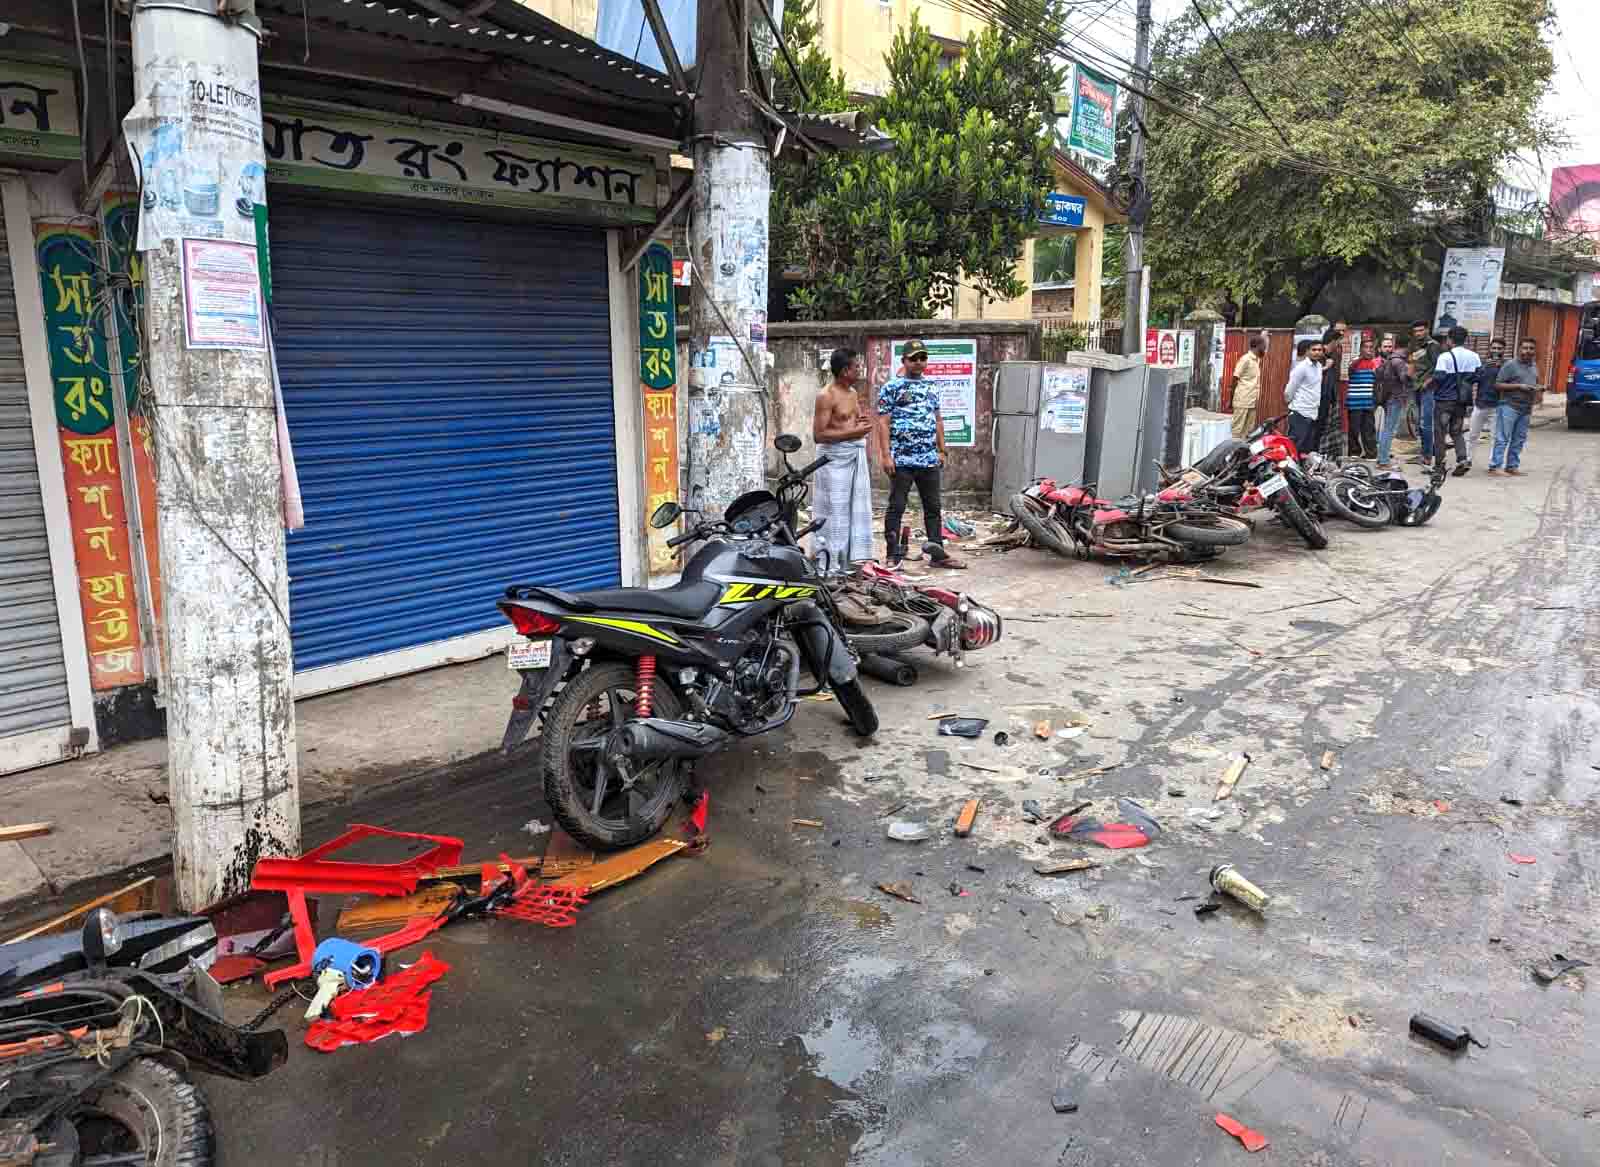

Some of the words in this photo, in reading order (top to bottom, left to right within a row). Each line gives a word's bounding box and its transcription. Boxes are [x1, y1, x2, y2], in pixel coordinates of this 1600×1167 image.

[189, 80, 232, 105] TO-LET
[386, 138, 467, 181] রং
[484, 149, 642, 204] ফ্যাশন
